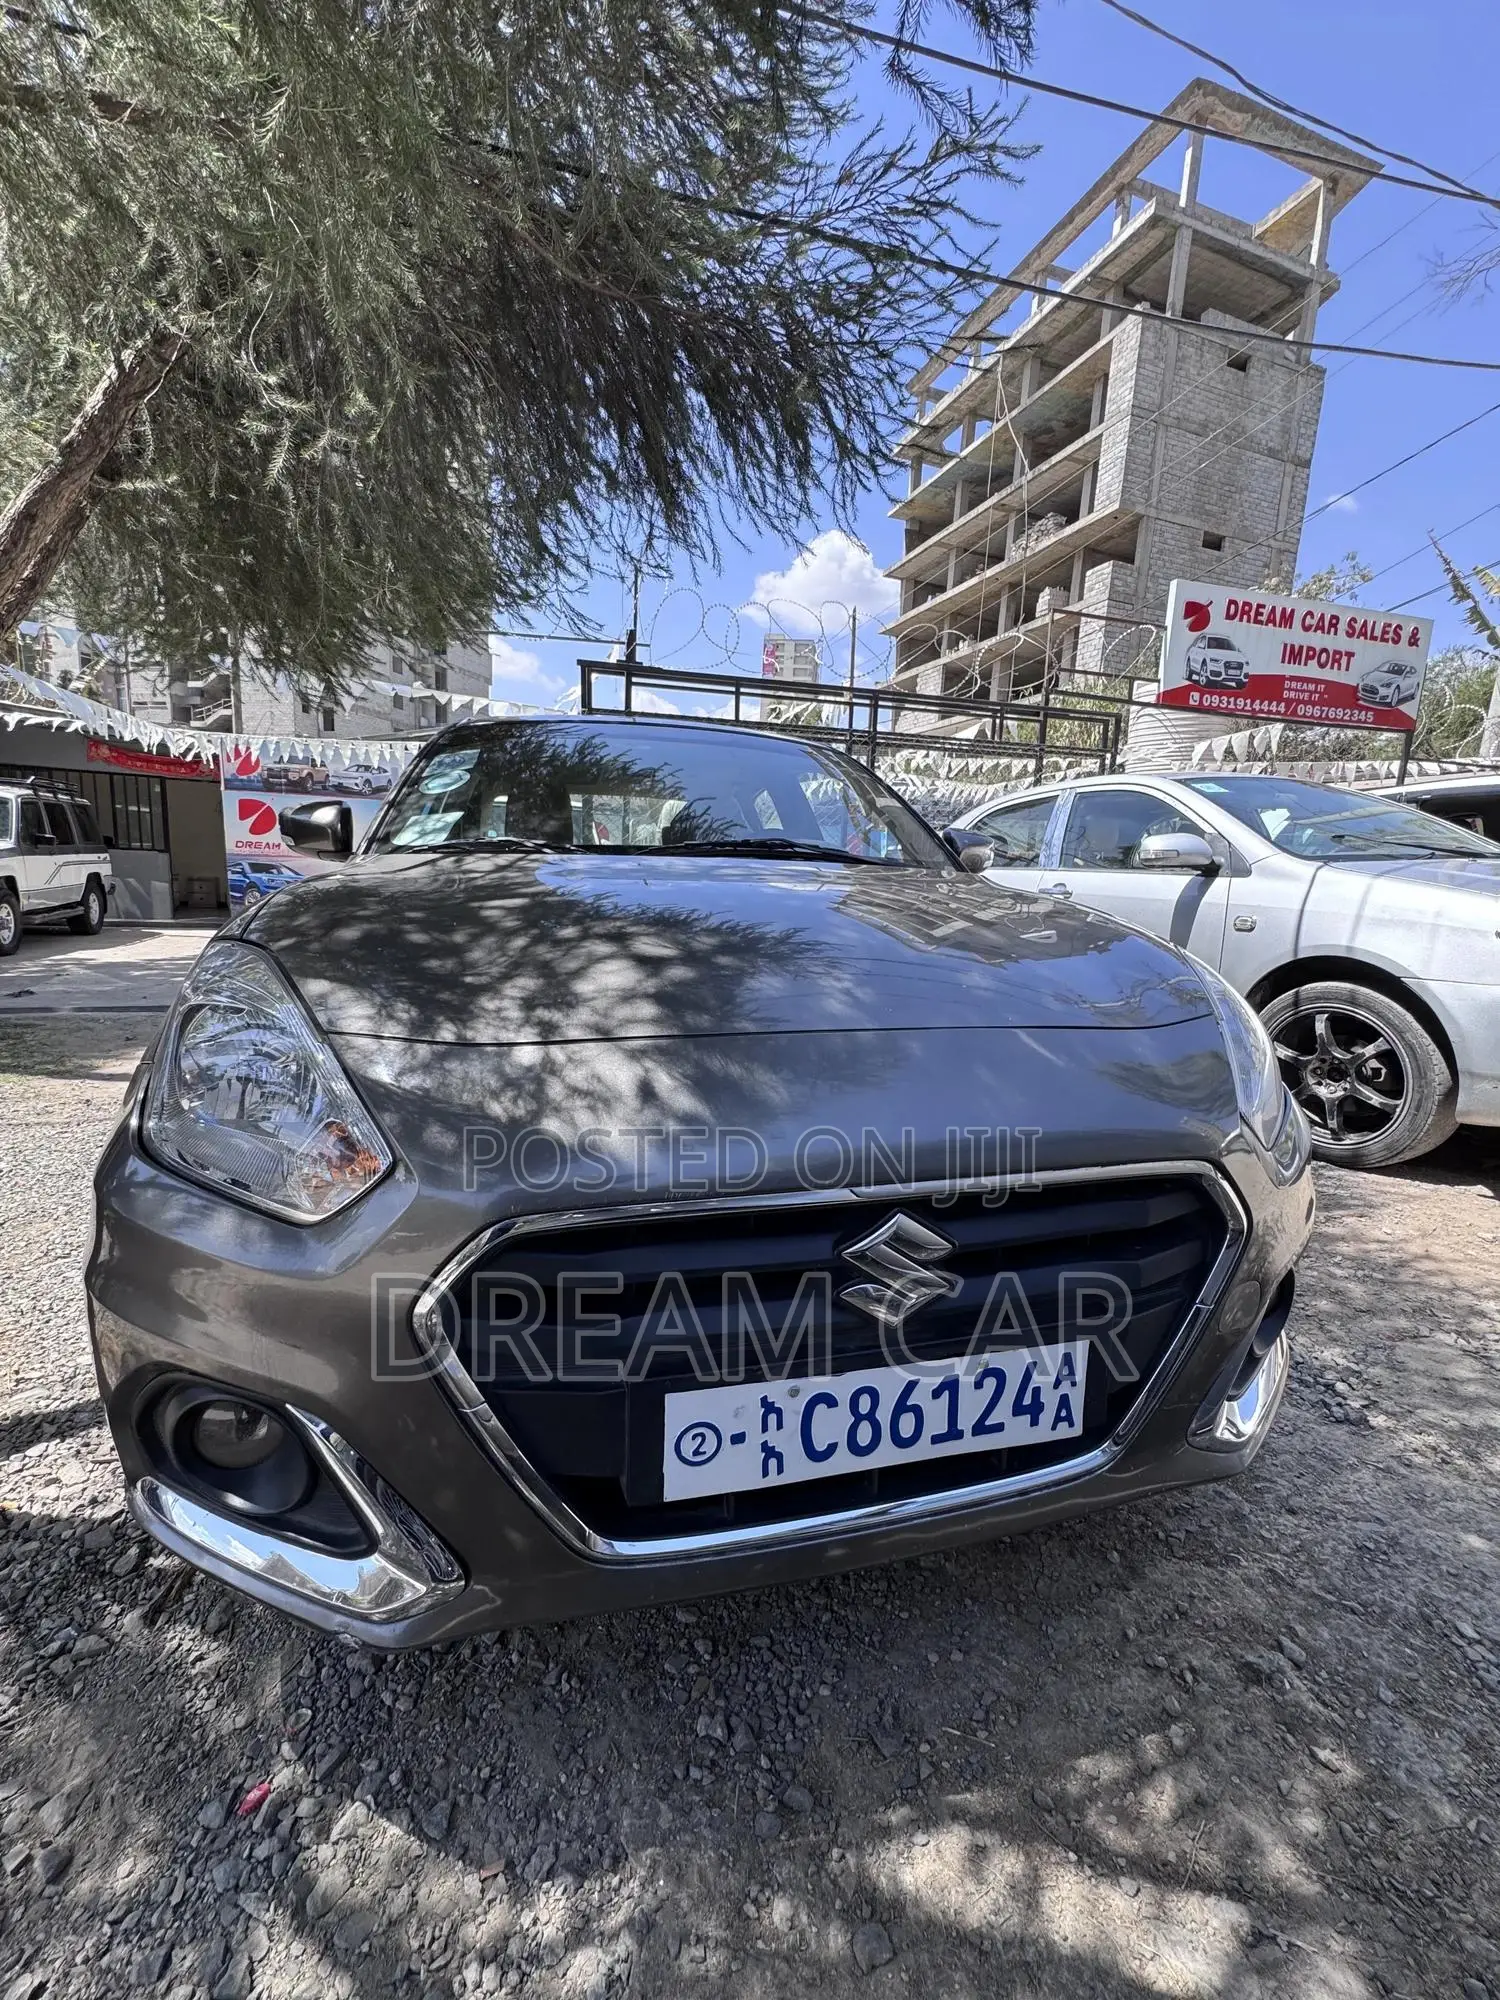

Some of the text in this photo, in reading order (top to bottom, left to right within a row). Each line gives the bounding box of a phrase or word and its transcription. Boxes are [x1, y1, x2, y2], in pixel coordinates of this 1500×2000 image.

[1225, 598, 1420, 648] DREAM CAR SALES &
[1281, 642, 1356, 672] IMPORT
[1283, 690, 1310, 700] DRIVE
[1284, 680, 1326, 692] DREAM IT
[1202, 694, 1286, 713] 0931914444
[1297, 704, 1374, 723] 0967692345
[235, 840, 281, 850] DREAM
[800, 1360, 1045, 1463] C86124
